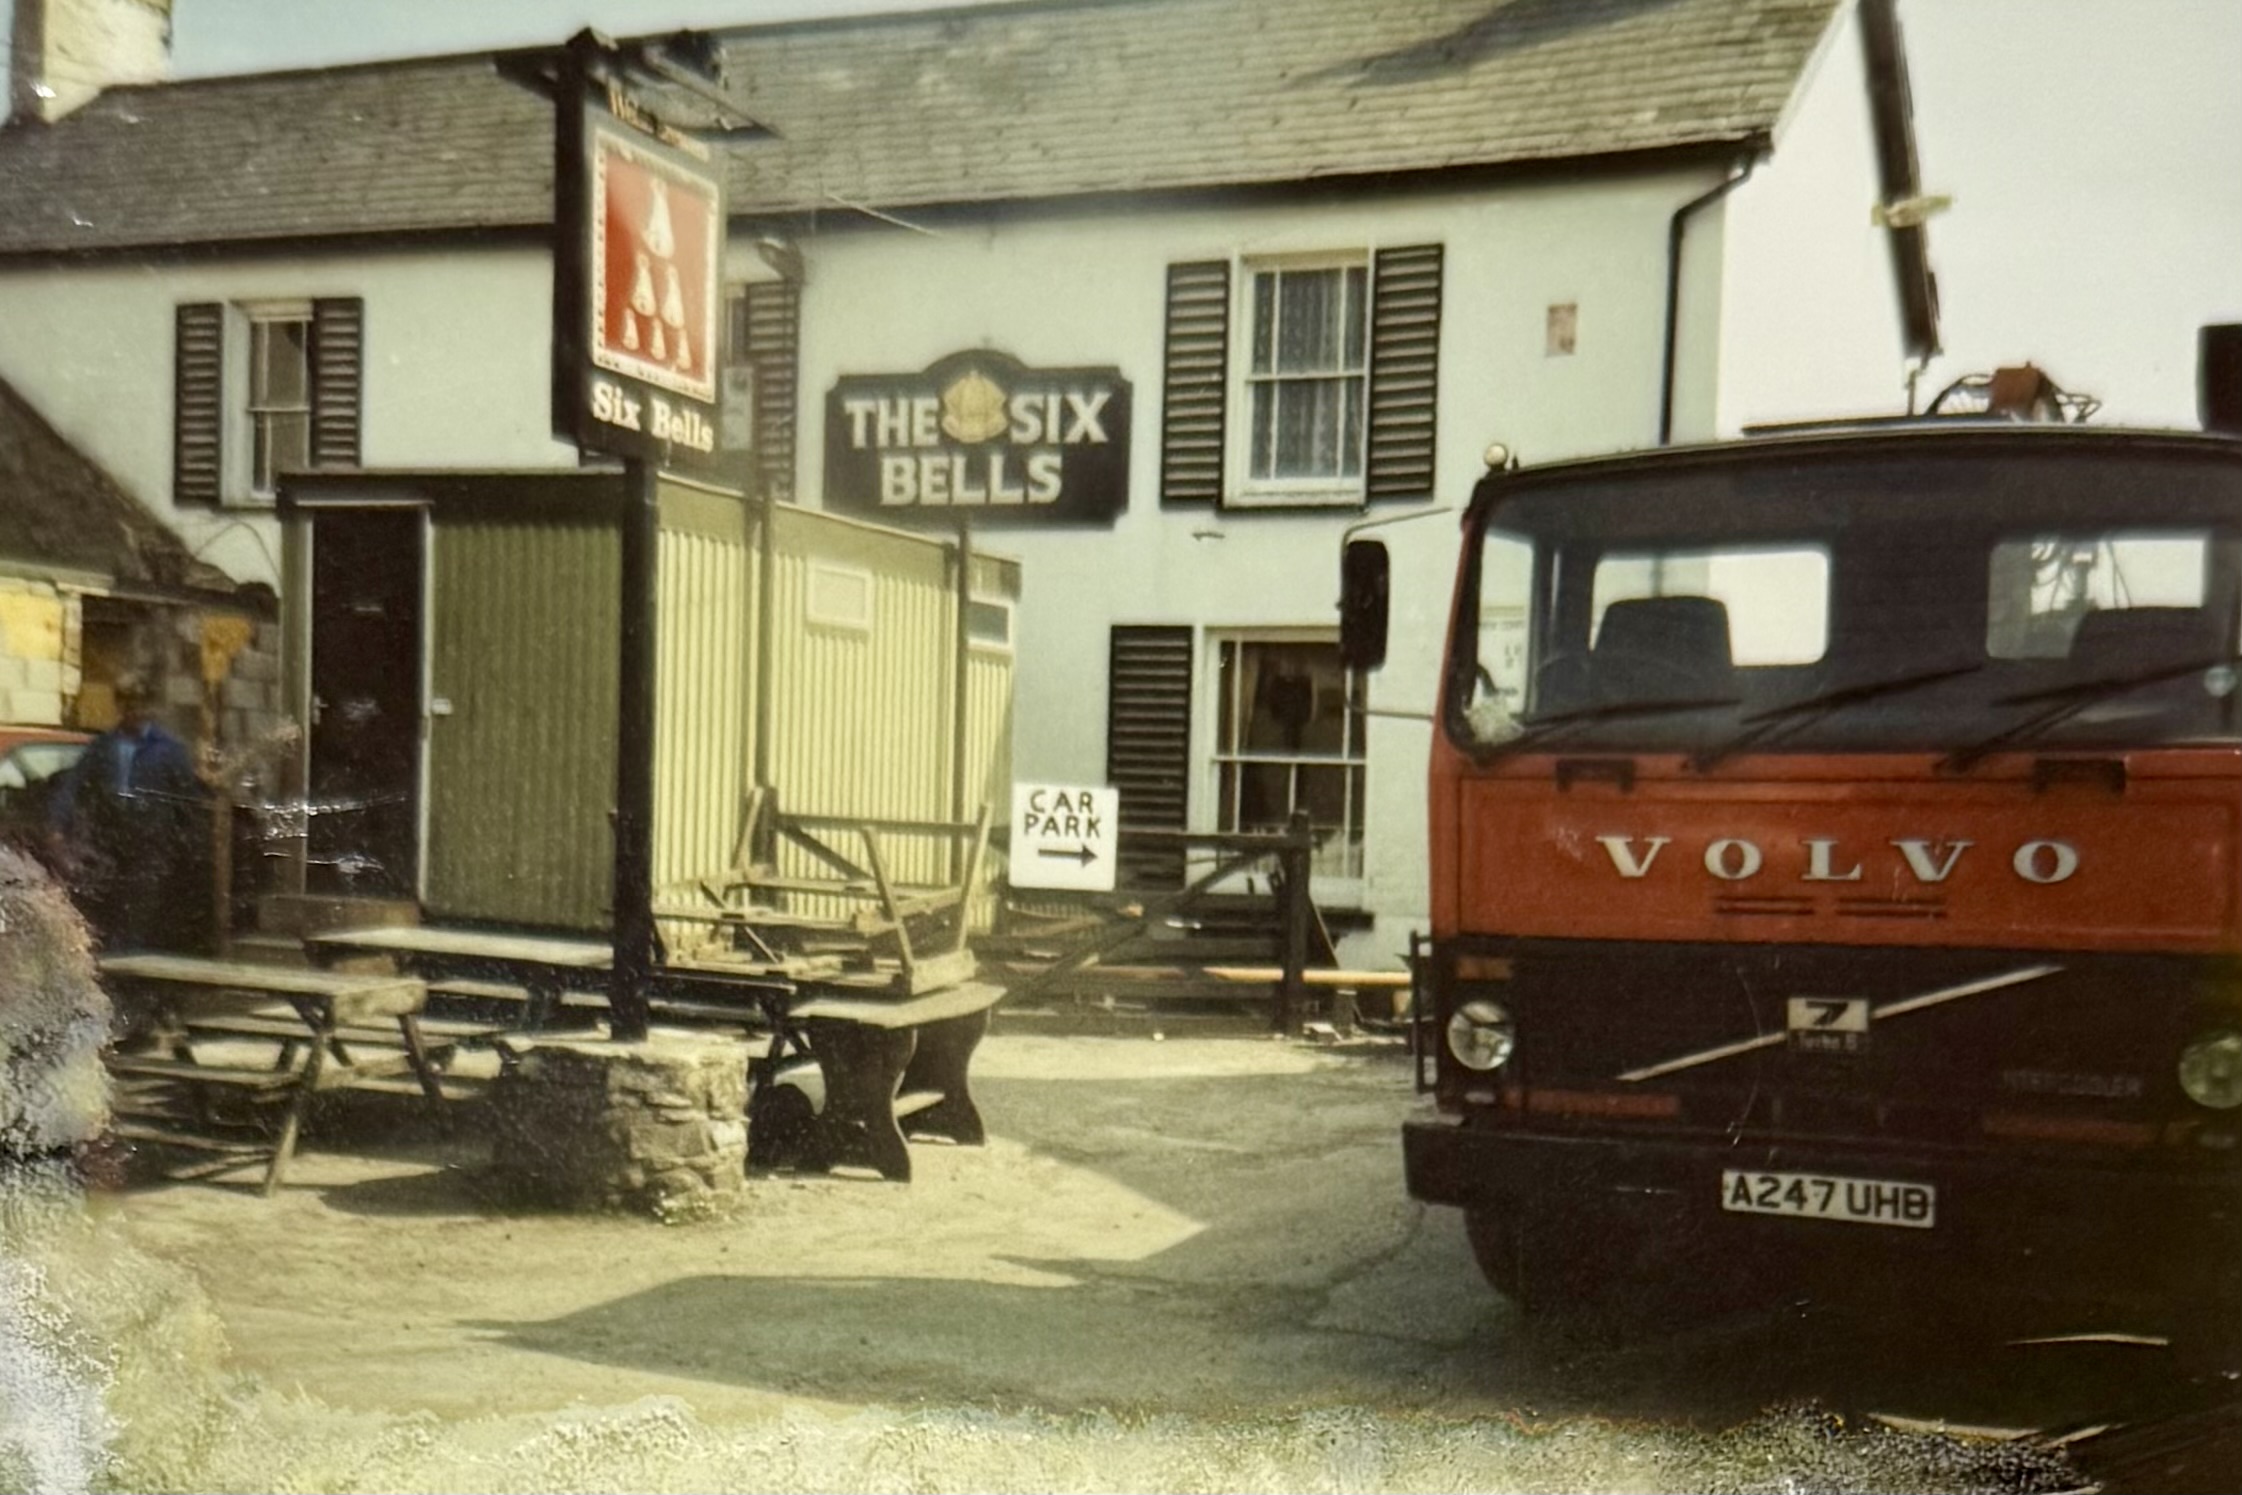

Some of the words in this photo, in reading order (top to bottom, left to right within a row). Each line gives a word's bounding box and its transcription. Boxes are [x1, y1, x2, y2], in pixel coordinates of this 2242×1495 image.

[593, 381, 641, 432] Six
[652, 399, 714, 453] Bells
[844, 397, 940, 449] THE
[1009, 391, 1112, 445] SIX
[880, 454, 1063, 506] BELLS
[1024, 812, 1101, 839] PARK
[1030, 789, 1094, 815] CAR
[1595, 835, 2079, 884] VOLVO
[1730, 1175, 1836, 1212] A247
[1846, 1182, 1930, 1221] UHB
